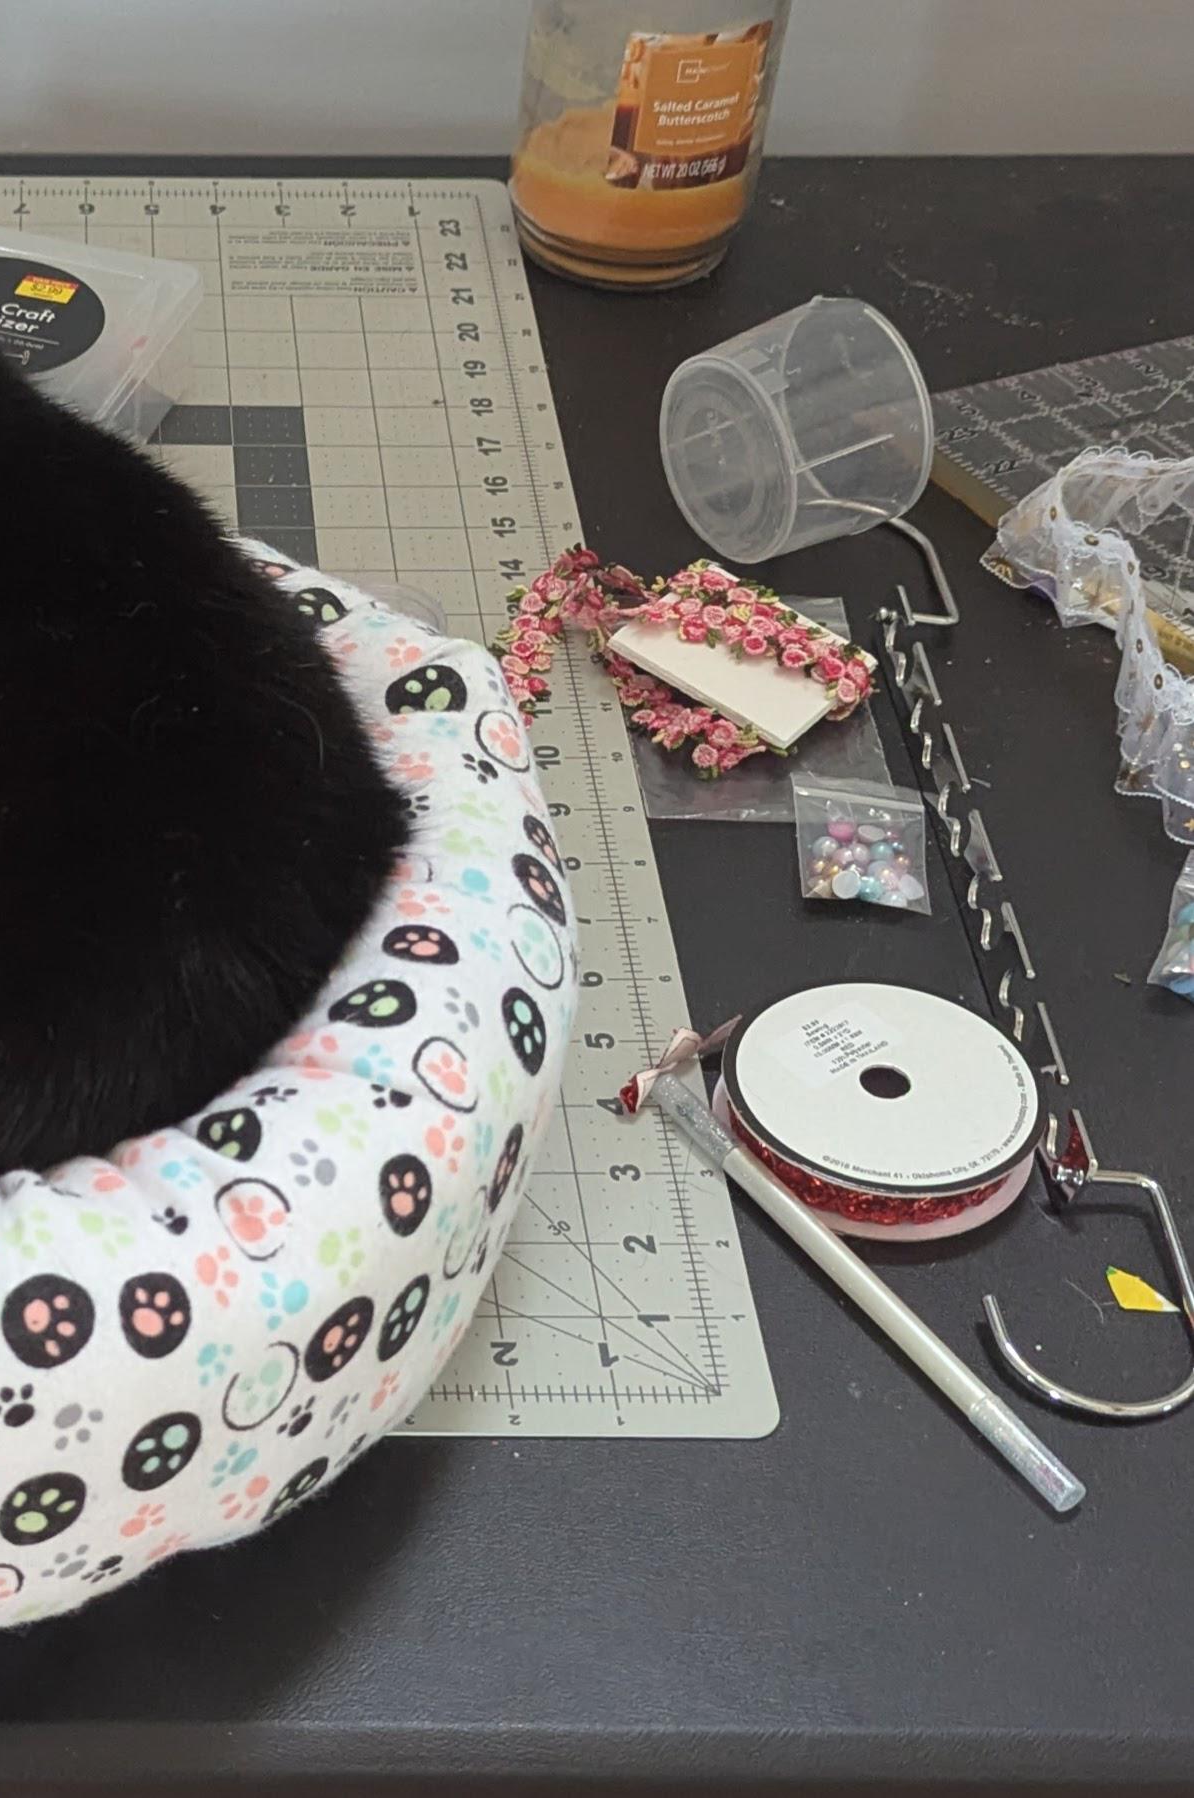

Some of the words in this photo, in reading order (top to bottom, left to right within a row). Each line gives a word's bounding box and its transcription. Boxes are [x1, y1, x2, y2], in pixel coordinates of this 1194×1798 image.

[653, 100, 692, 113] Salted
[695, 91, 740, 110] Caramel
[658, 109, 730, 126] Butterscotch
[13, 202, 30, 214] 7
[439, 219, 461, 237] 23
[445, 252, 468, 271] 22
[451, 288, 474, 305] 21
[1, 303, 56, 323] Craft
[457, 322, 480, 342] 20
[463, 360, 486, 378] 19
[470, 398, 494, 416] 18
[477, 436, 502, 456] 17
[484, 476, 508, 496] 16
[491, 516, 517, 538] 15
[499, 559, 525, 581] 14
[533, 745, 561, 770] 10
[611, 751, 623, 763] 10
[623, 805, 635, 814] 9
[634, 859, 646, 867] 8
[647, 917, 658, 925] 7
[580, 971, 604, 988] 6
[658, 975, 672, 983] 6
[585, 1033, 615, 1050] 5
[609, 1164, 641, 1181] 3
[700, 1169, 714, 1178] 3
[852, 1165, 891, 1178] Merchant
[912, 1170, 952, 1180] Oklahoma
[547, 1219, 572, 1237] 30
[623, 1234, 657, 1255] 2
[715, 1239, 729, 1249] 2
[638, 1312, 670, 1328] 1
[731, 1313, 747, 1323] 1
[489, 1341, 520, 1367] 2
[598, 1341, 620, 1368] 1
[508, 1415, 522, 1426] 2
[616, 1416, 625, 1426] 1
